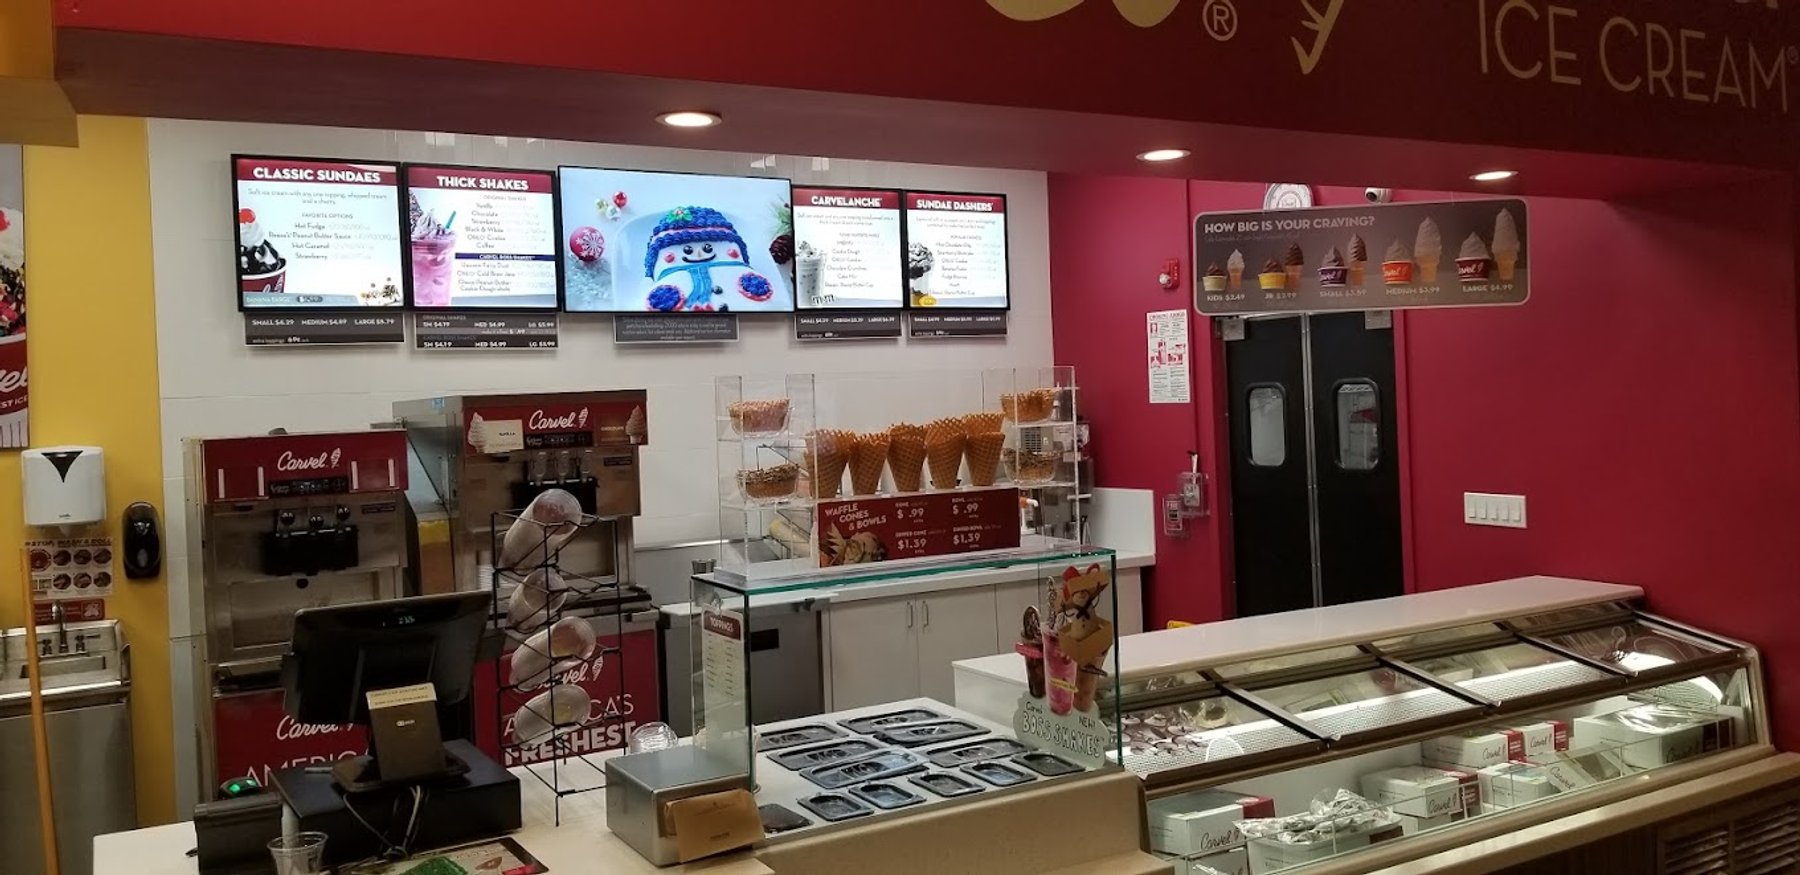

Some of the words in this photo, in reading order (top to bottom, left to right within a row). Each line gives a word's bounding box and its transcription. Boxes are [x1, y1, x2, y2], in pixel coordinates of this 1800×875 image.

[1478, 0, 1581, 85] ICE
[1600, 16, 1788, 113] CREAM
[253, 167, 315, 181] CLASSIC
[316, 170, 381, 183] SUNDAES
[437, 176, 477, 188] THICK
[479, 179, 529, 190] SHAKES
[916, 199, 953, 210] SUNDAE
[953, 202, 993, 212] DASHERS
[307, 223, 326, 231] Fudge
[471, 218, 501, 226] Strawberry
[1204, 222, 1236, 234] HOW
[1237, 221, 1260, 233] BIG
[1261, 220, 1273, 231] IS
[1275, 219, 1311, 231] YOUR
[1312, 215, 1376, 230] CRAVING?
[1319, 289, 1343, 298] SMALL
[1385, 287, 1417, 296] MEDIUM
[1462, 284, 1488, 293] LARGE
[1206, 294, 1223, 302] KIDS
[1264, 292, 1274, 300] JR
[529, 409, 576, 430] Carvel
[277, 451, 327, 471] Carvel
[825, 503, 859, 517] WAFFLE
[839, 509, 870, 523] CONES
[856, 515, 887, 529] BOWLS
[1025, 701, 1043, 714] Carvel
[1022, 710, 1051, 742] BOSS
[1053, 723, 1101, 758] SHAKES
[1530, 735, 1548, 748] Carvel
[1482, 744, 1500, 760] Carvel
[1428, 797, 1453, 812] Carvel
[1200, 830, 1232, 851] Carvel
